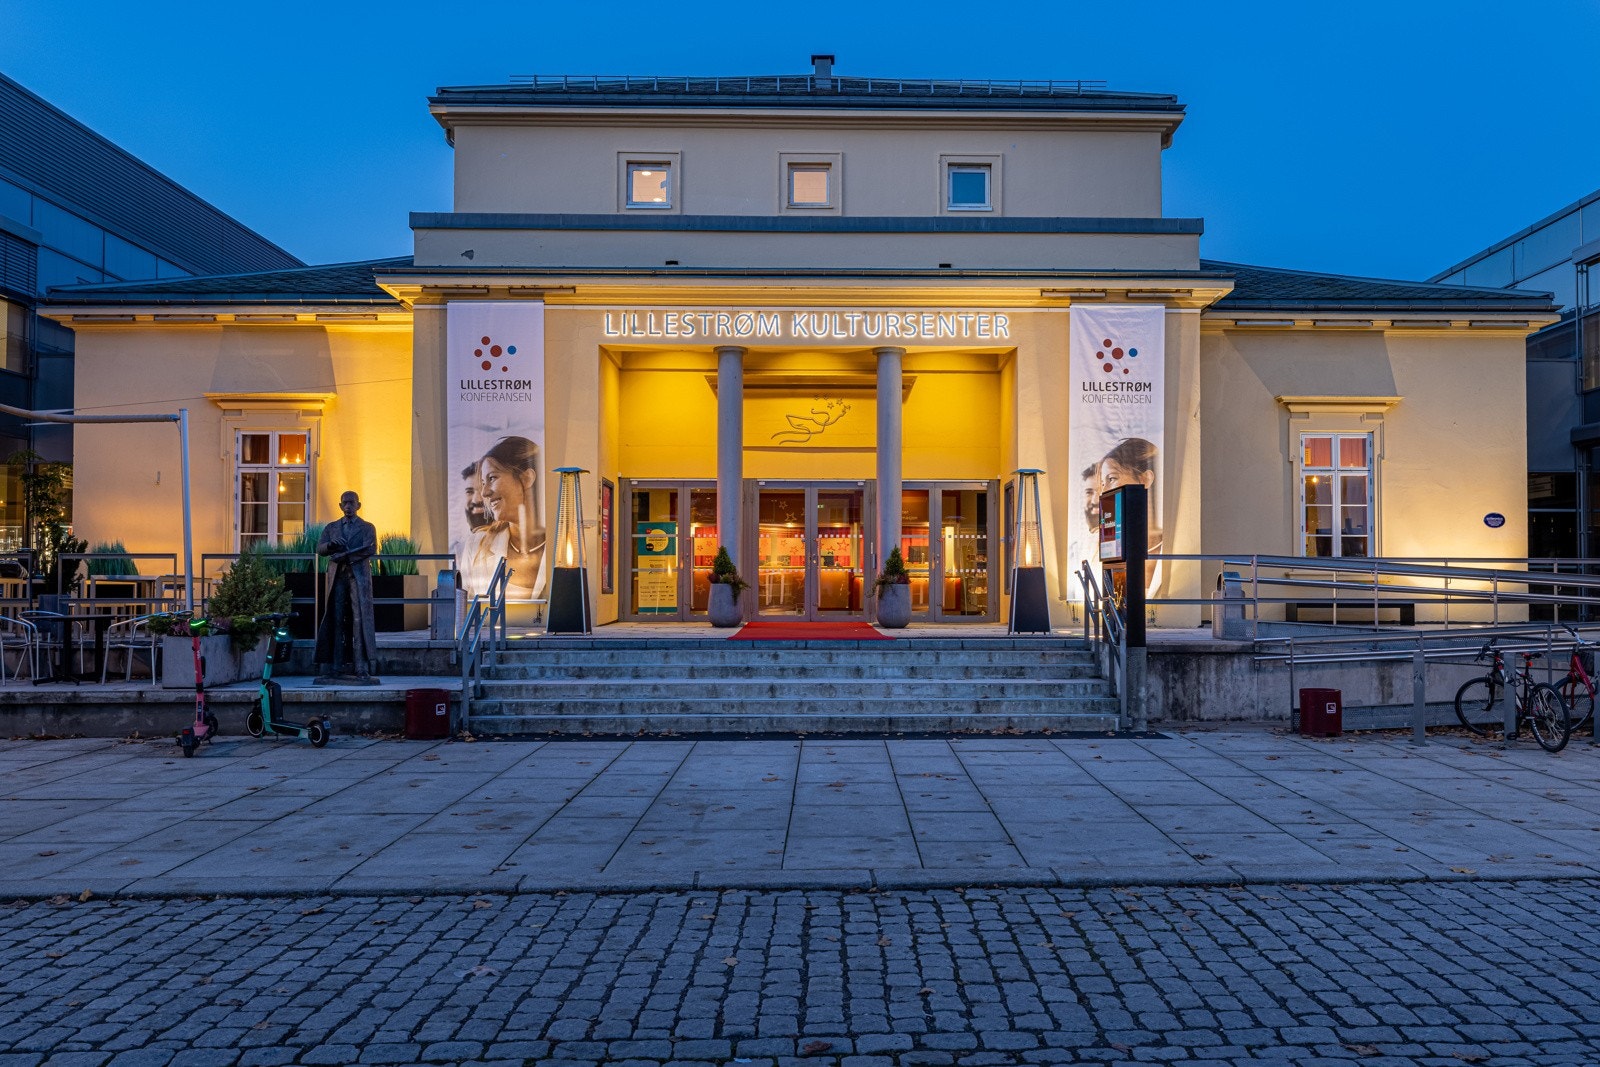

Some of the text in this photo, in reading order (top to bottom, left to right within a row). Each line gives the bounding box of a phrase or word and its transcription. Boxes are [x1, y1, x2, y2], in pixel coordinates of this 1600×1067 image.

[605, 312, 1010, 338] LILLESTRØM KULTURSENTER
[460, 379, 532, 390] LILLESTRØM
[1082, 381, 1152, 392] LILLESTRØM
[460, 392, 532, 402] KONFERANSEN
[1082, 394, 1152, 404] KONFERANSEN
